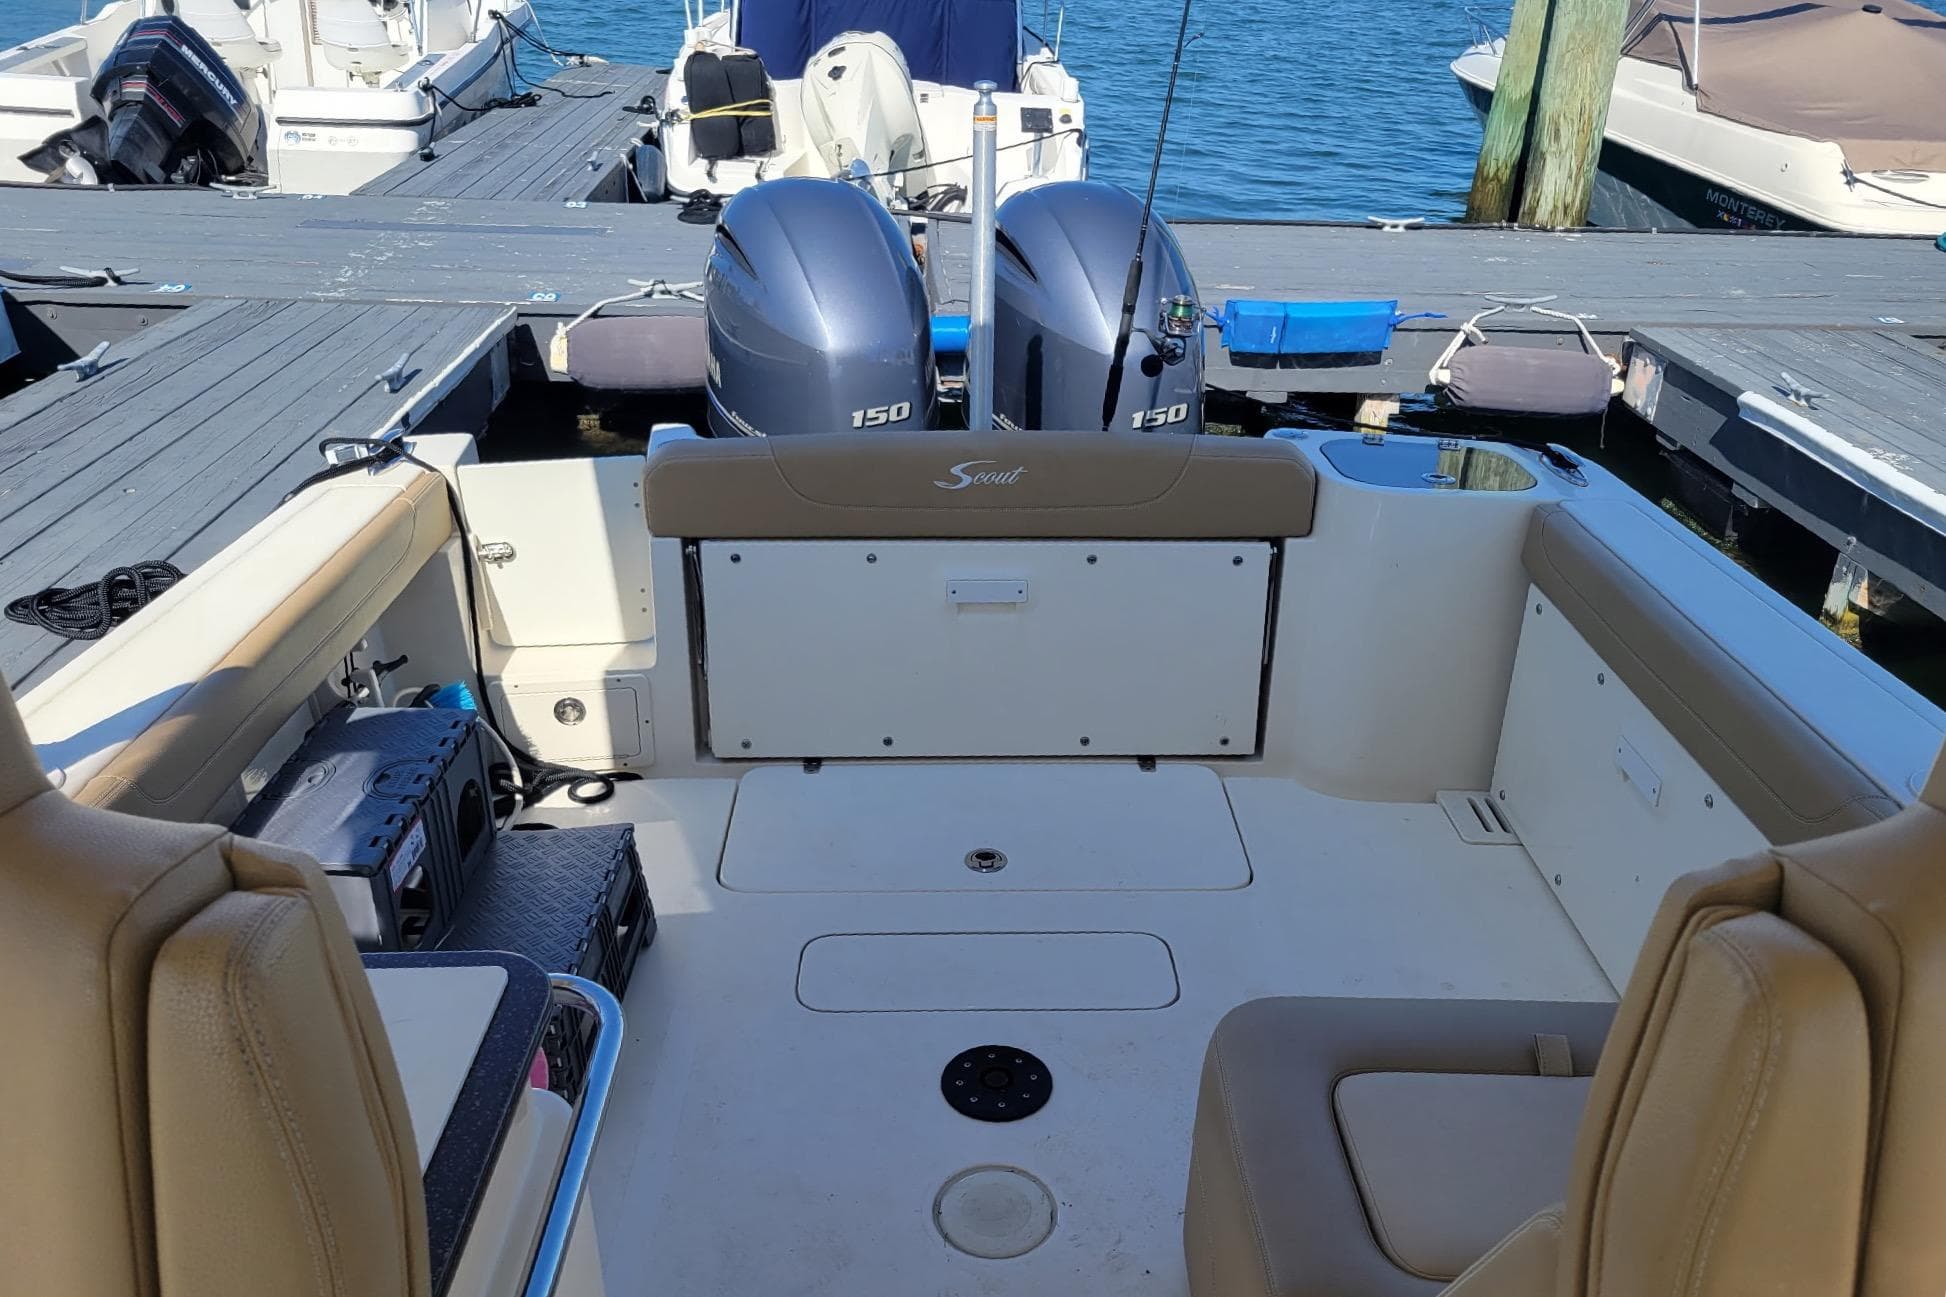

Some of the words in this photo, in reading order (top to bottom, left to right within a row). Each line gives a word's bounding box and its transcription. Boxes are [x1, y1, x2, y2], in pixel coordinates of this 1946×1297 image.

[180, 43, 239, 106] MERCURY
[1706, 187, 1787, 230] MONTEREY
[851, 401, 911, 428] 150
[1131, 402, 1189, 430] 150
[933, 460, 1029, 490] Scout
